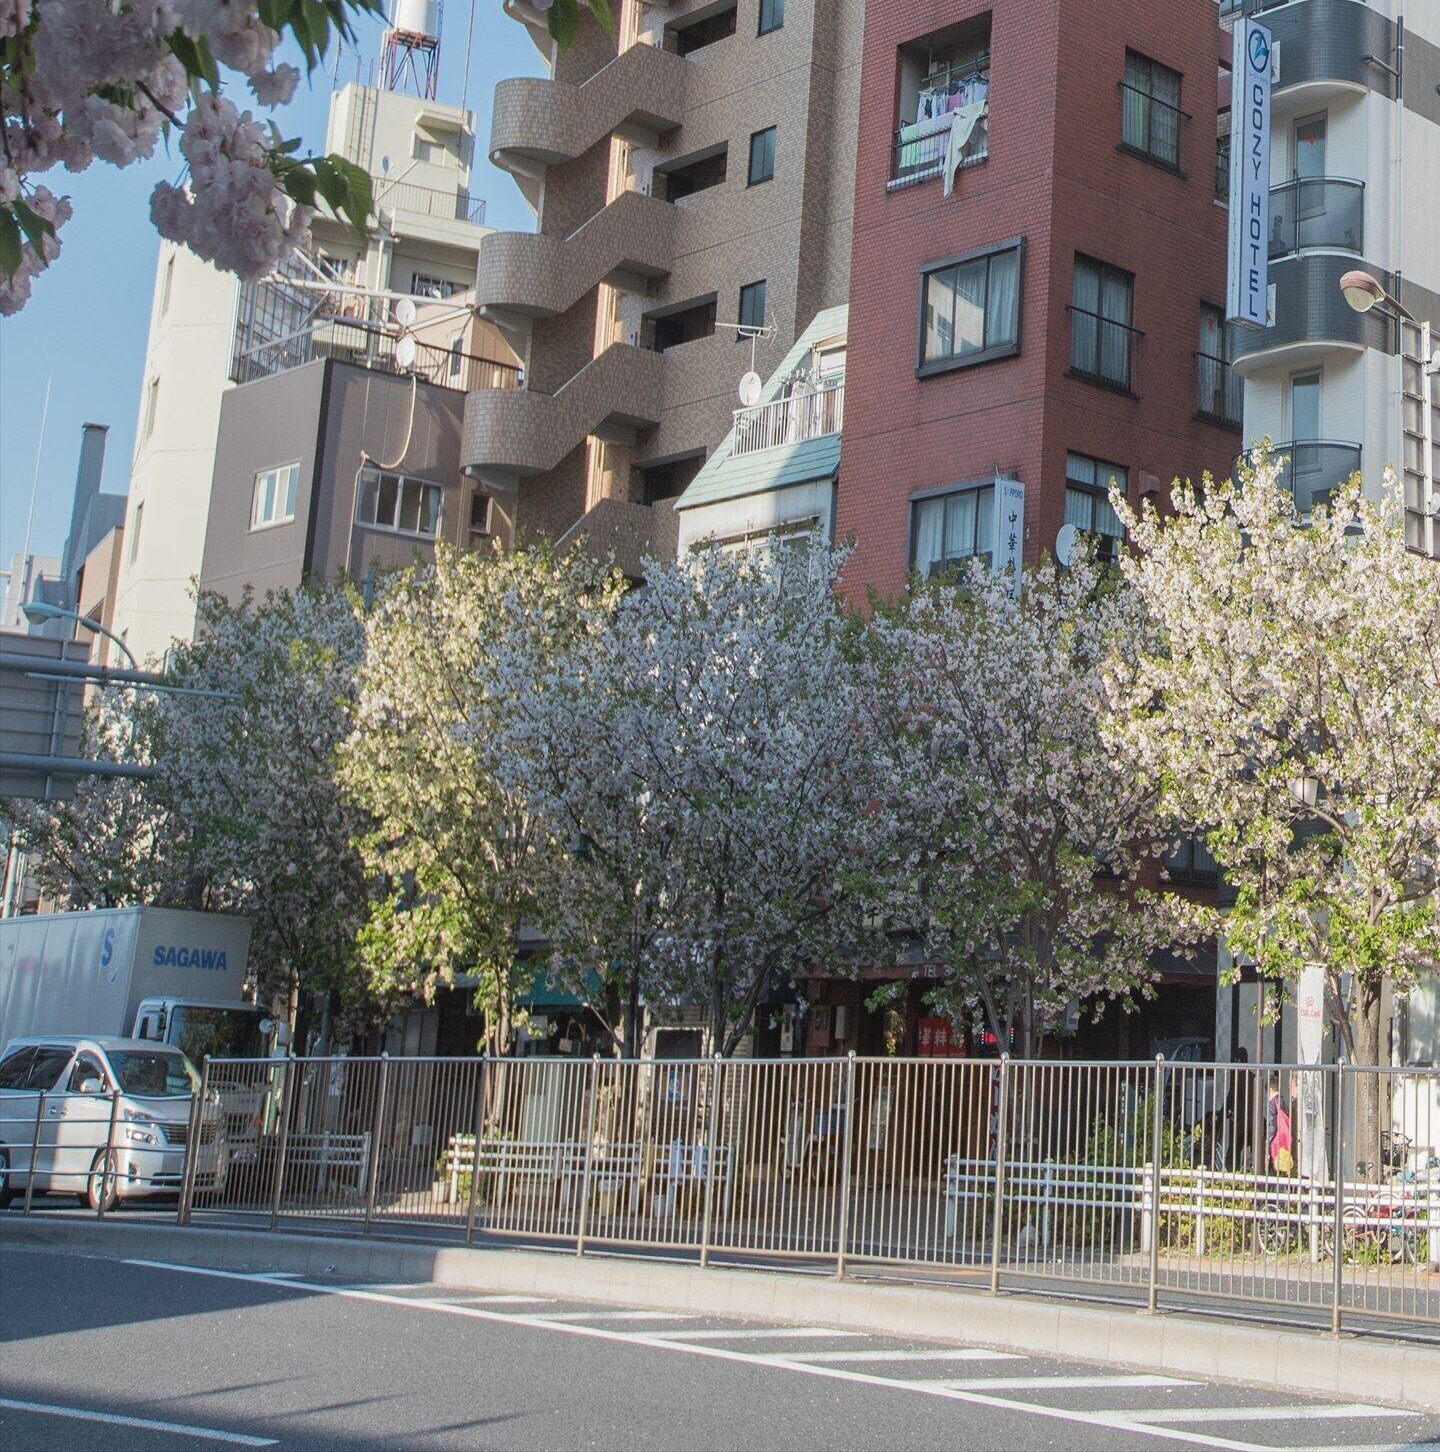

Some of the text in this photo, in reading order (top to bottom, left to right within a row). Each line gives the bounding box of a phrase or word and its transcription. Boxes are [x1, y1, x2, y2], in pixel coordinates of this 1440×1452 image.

[1251, 83, 1264, 181] COZY
[1248, 192, 1262, 318] HOTEL
[152, 944, 228, 972] SAGAWA
